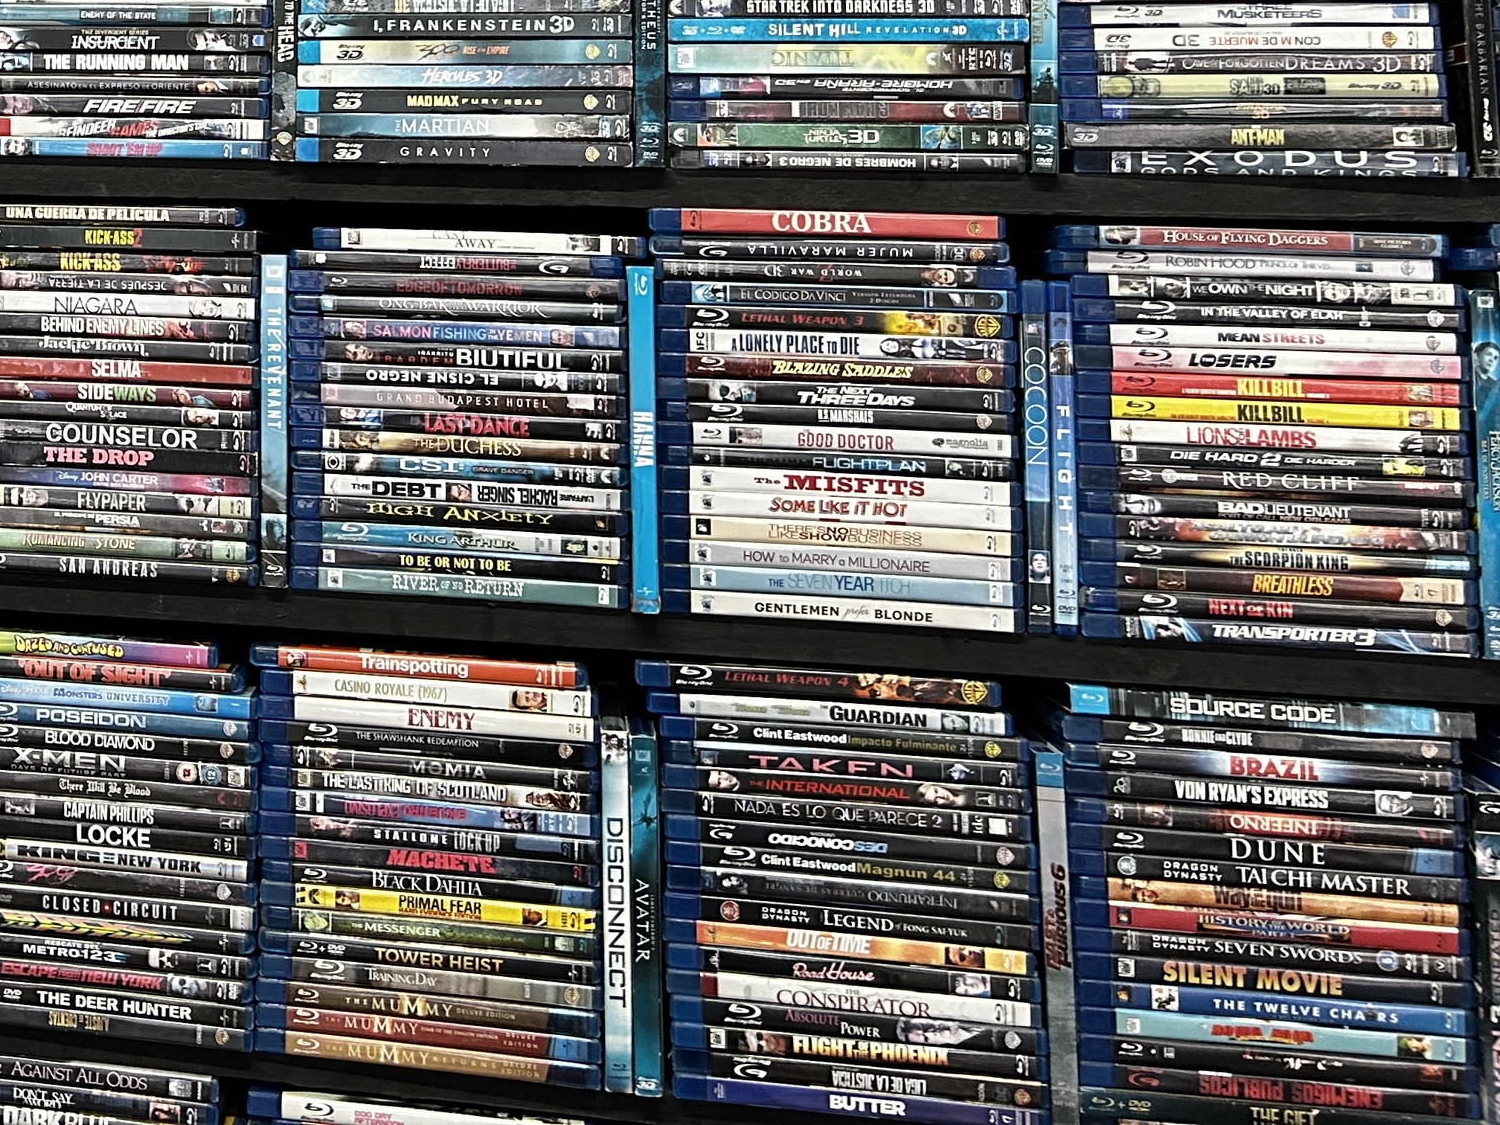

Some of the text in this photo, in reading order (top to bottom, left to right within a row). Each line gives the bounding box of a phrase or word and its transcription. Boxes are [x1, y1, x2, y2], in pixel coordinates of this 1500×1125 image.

[43, 54, 189, 70] THE RUNNING MAN
[399, 146, 491, 157] GRAVITY
[1140, 151, 1418, 167] EXODUS
[771, 212, 872, 234] COBRA
[54, 296, 138, 315] NIAGARA
[91, 361, 142, 378] SELMA
[456, 349, 570, 370] BIUTIFUL
[633, 411, 654, 467] HANNA
[43, 446, 154, 466] THE DROP
[371, 482, 442, 498] DEBT
[754, 476, 926, 497] The MISFITS
[1252, 575, 1334, 596] BREATHLESS
[359, 653, 469, 678] Trainspotting
[35, 709, 148, 728] POSEIDON
[407, 708, 476, 730] ENEMY
[829, 706, 927, 728] GUARDIAN
[1169, 697, 1337, 724] SOURCE CODE
[76, 824, 151, 848] LOCKE
[386, 849, 497, 874] MACHETE
[1230, 838, 1327, 866] DUNE
[607, 817, 627, 1007] DISCONNECT
[635, 878, 651, 962] AVATAR
[374, 948, 504, 973] TOWER HEIST
[1162, 961, 1344, 996] SILENT MOVIE
[36, 990, 192, 1020] THE DEER HUNTER
[829, 1095, 906, 1116] BUTTER
